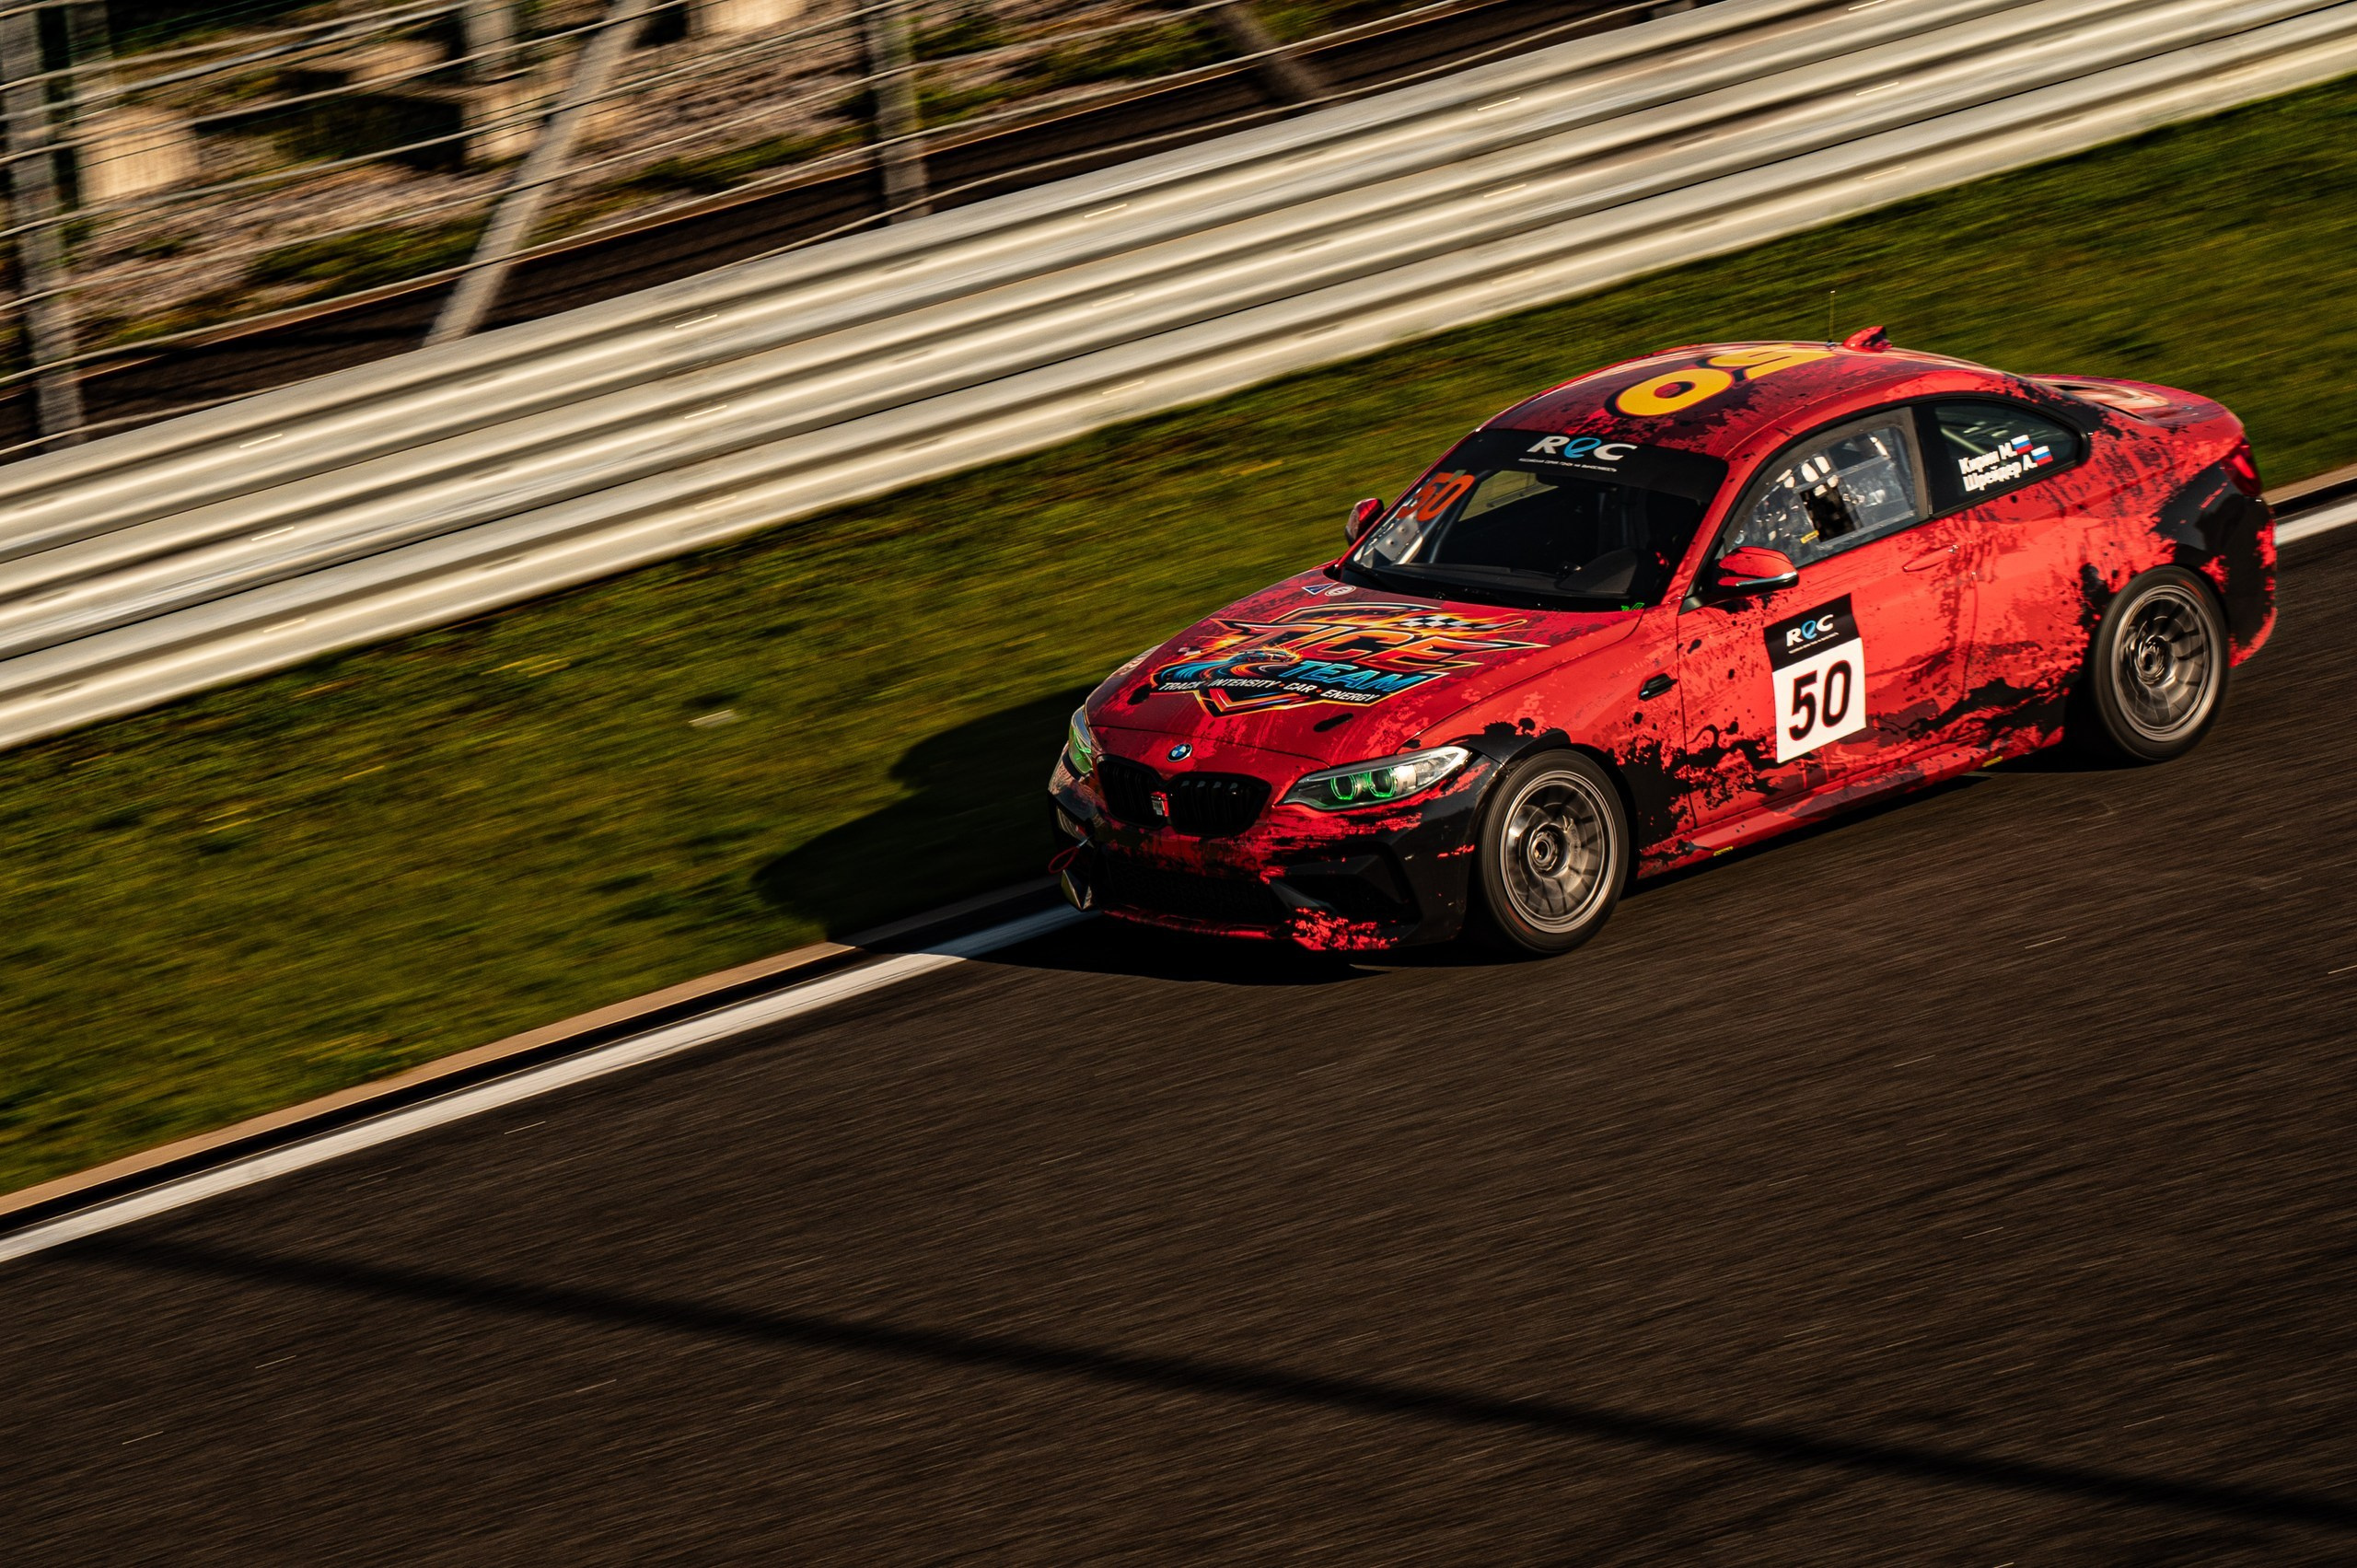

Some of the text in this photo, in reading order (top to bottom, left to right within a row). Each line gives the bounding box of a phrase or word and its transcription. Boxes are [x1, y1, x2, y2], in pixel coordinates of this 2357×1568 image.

[1395, 472, 1476, 522] 50
[1158, 678, 1381, 703] TRACK INTENSITY CAR ENERGY
[1278, 660, 1428, 691] TEAM
[1789, 660, 1852, 741] 50
